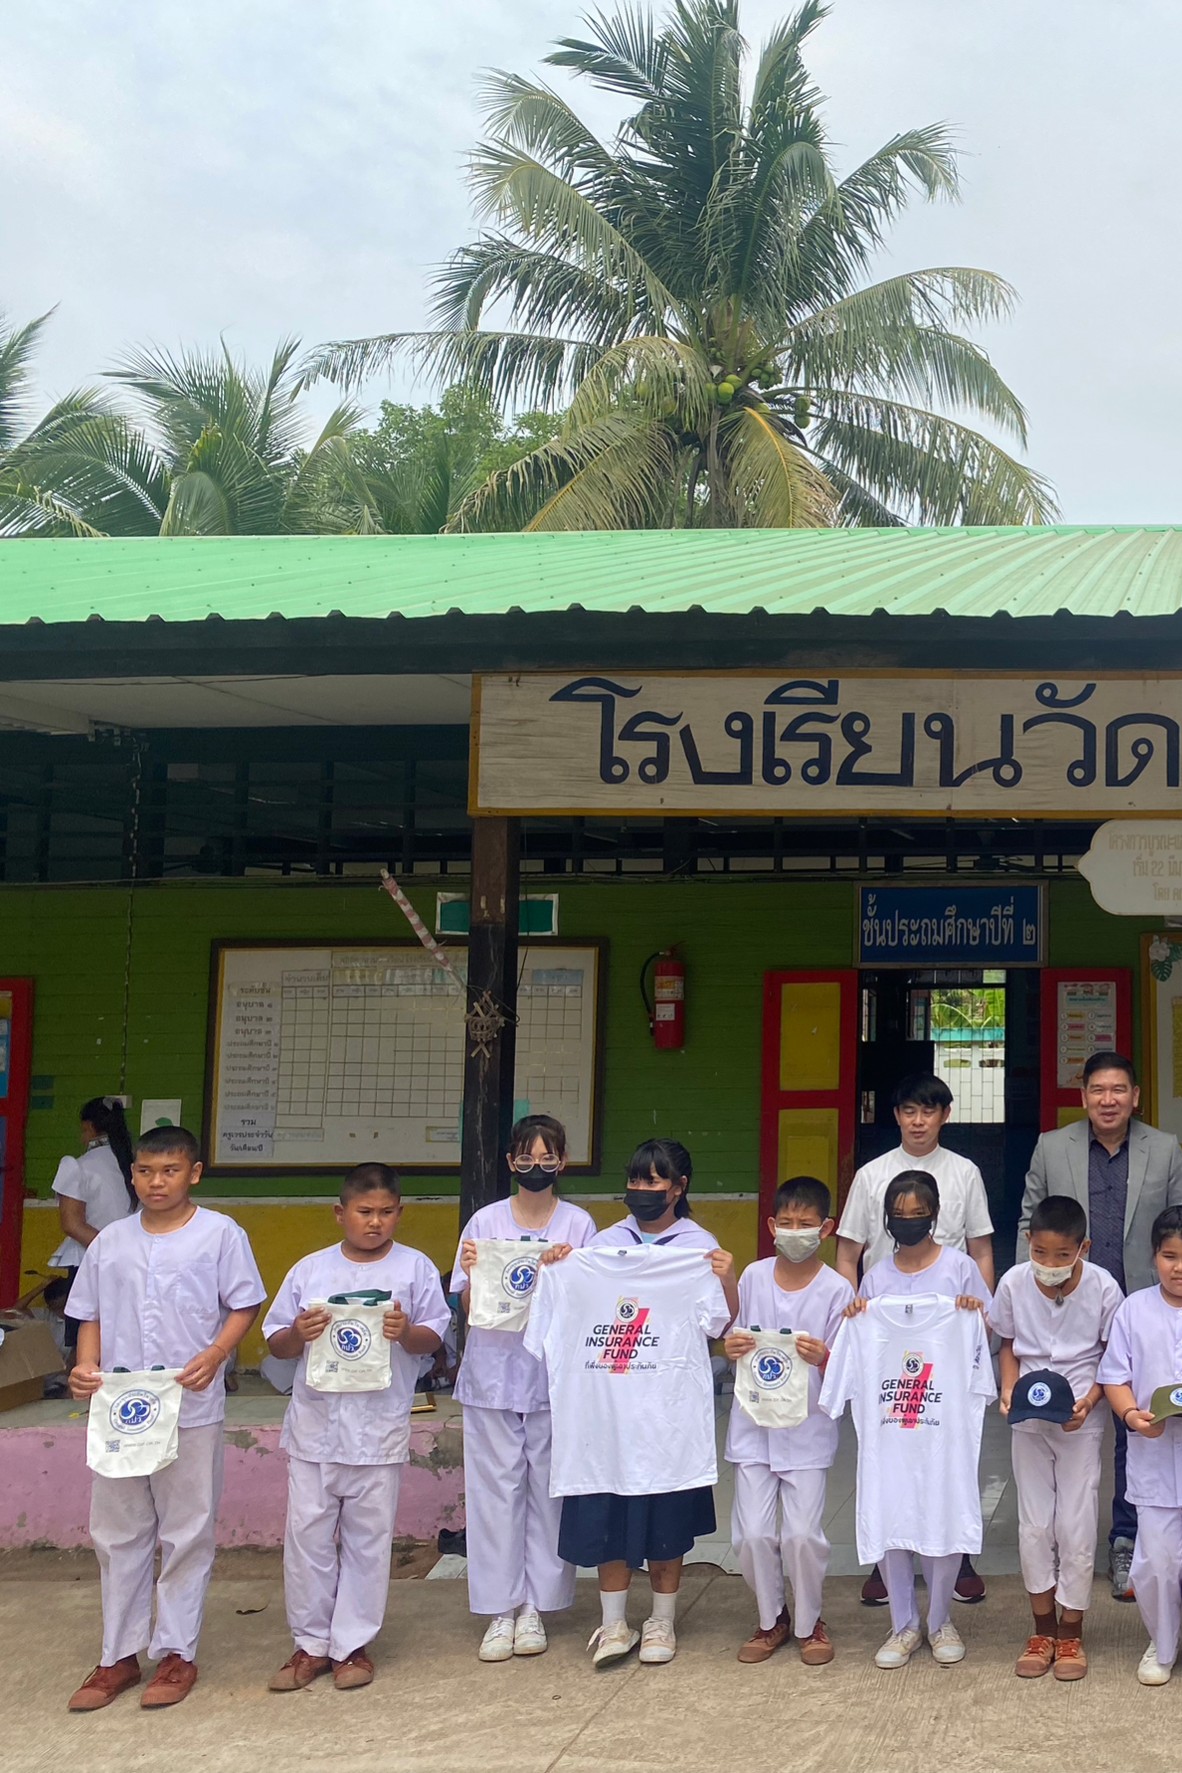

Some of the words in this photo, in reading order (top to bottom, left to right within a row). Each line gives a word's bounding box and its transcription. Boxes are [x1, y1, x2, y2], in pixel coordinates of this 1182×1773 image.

[862, 893, 1014, 947] ชั้นประถมศึกษาปีที่
[1022, 918, 1037, 946] ๒
[241, 1118, 257, 1126] รวม
[593, 1323, 652, 1336] GENERAL
[584, 1336, 660, 1348] INSURANCE
[602, 1348, 639, 1360] FUND
[881, 1379, 935, 1391] GENERAL
[892, 1403, 926, 1414] FUND
